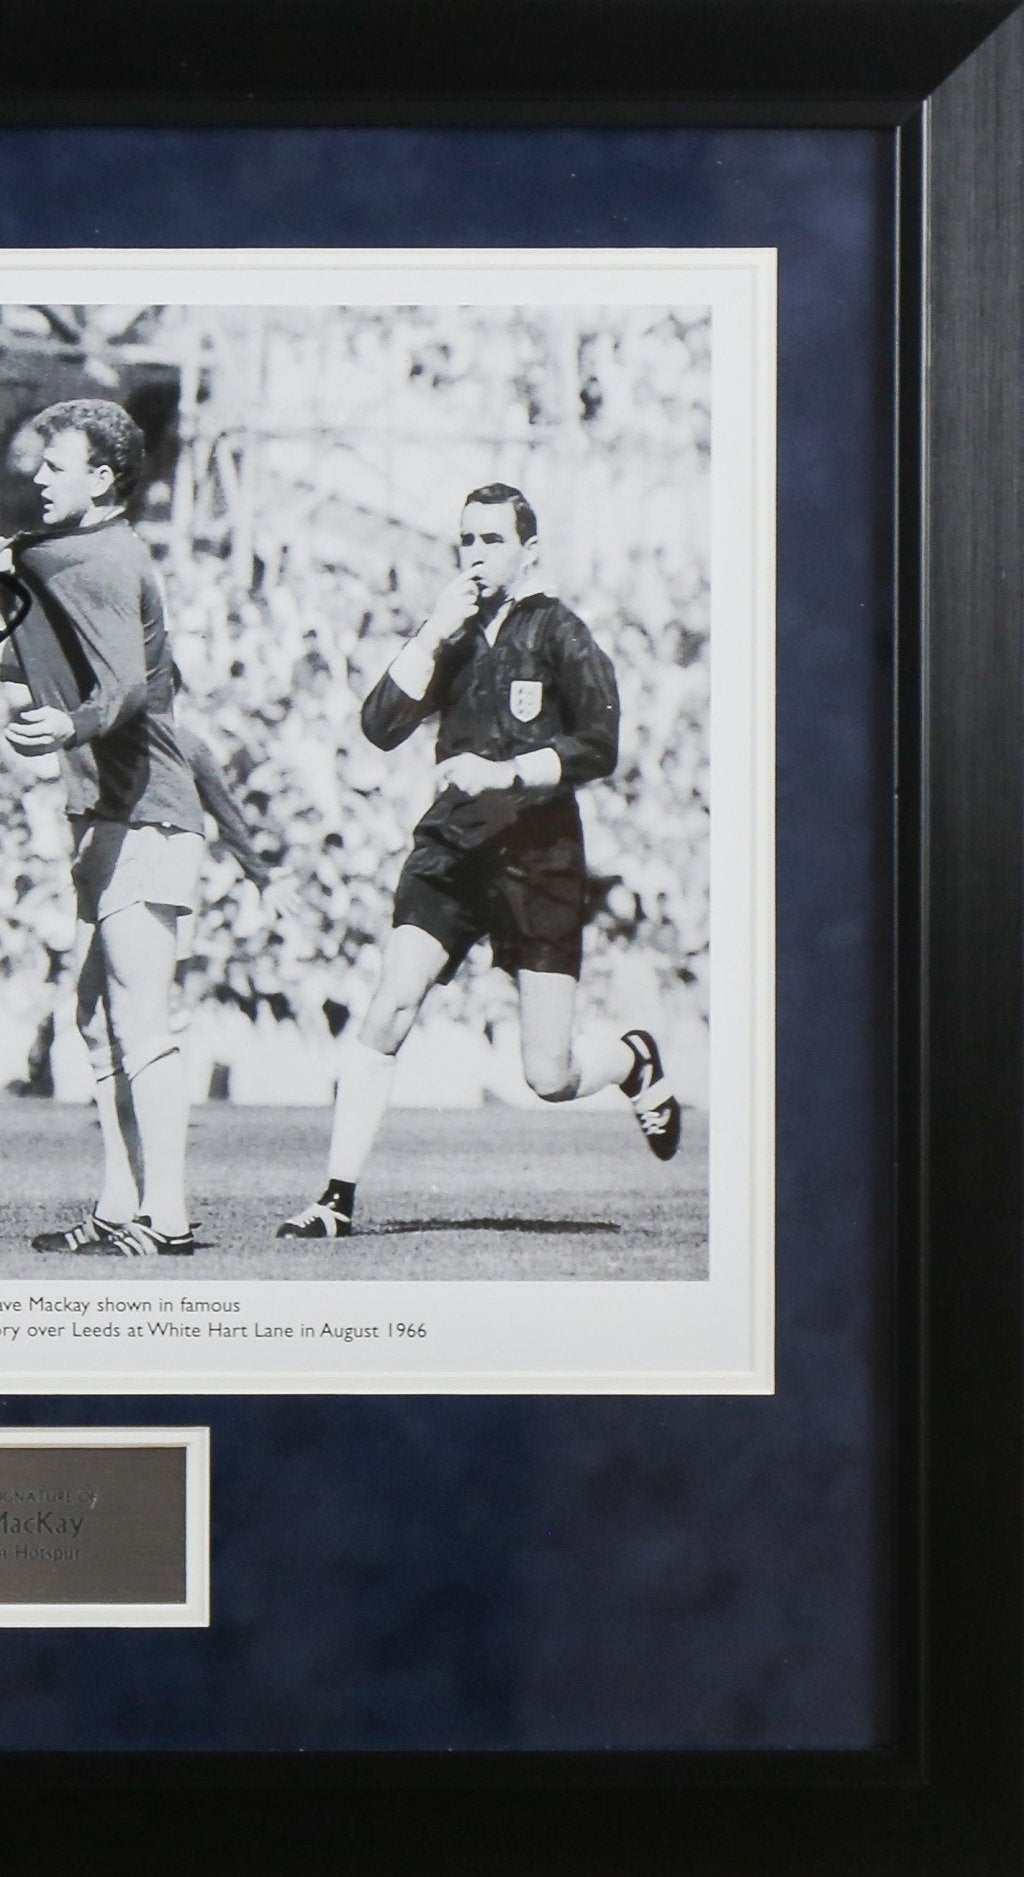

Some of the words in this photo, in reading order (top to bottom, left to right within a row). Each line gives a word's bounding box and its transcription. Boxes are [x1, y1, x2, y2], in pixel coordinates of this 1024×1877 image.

[29, 1297, 90, 1316] Mackay
[97, 1297, 151, 1312] shown
[159, 1297, 173, 1312] in
[180, 1297, 240, 1312] famous
[27, 1326, 65, 1337] over
[73, 1322, 120, 1337] Leeds
[128, 1324, 144, 1337] at
[147, 1322, 201, 1337] White
[208, 1323, 248, 1337] Hart
[255, 1323, 293, 1338] Lane
[301, 1323, 315, 1337] in
[320, 1323, 379, 1342] August
[388, 1323, 427, 1338] 1966
[15, 1544, 81, 1562] Hotspur
